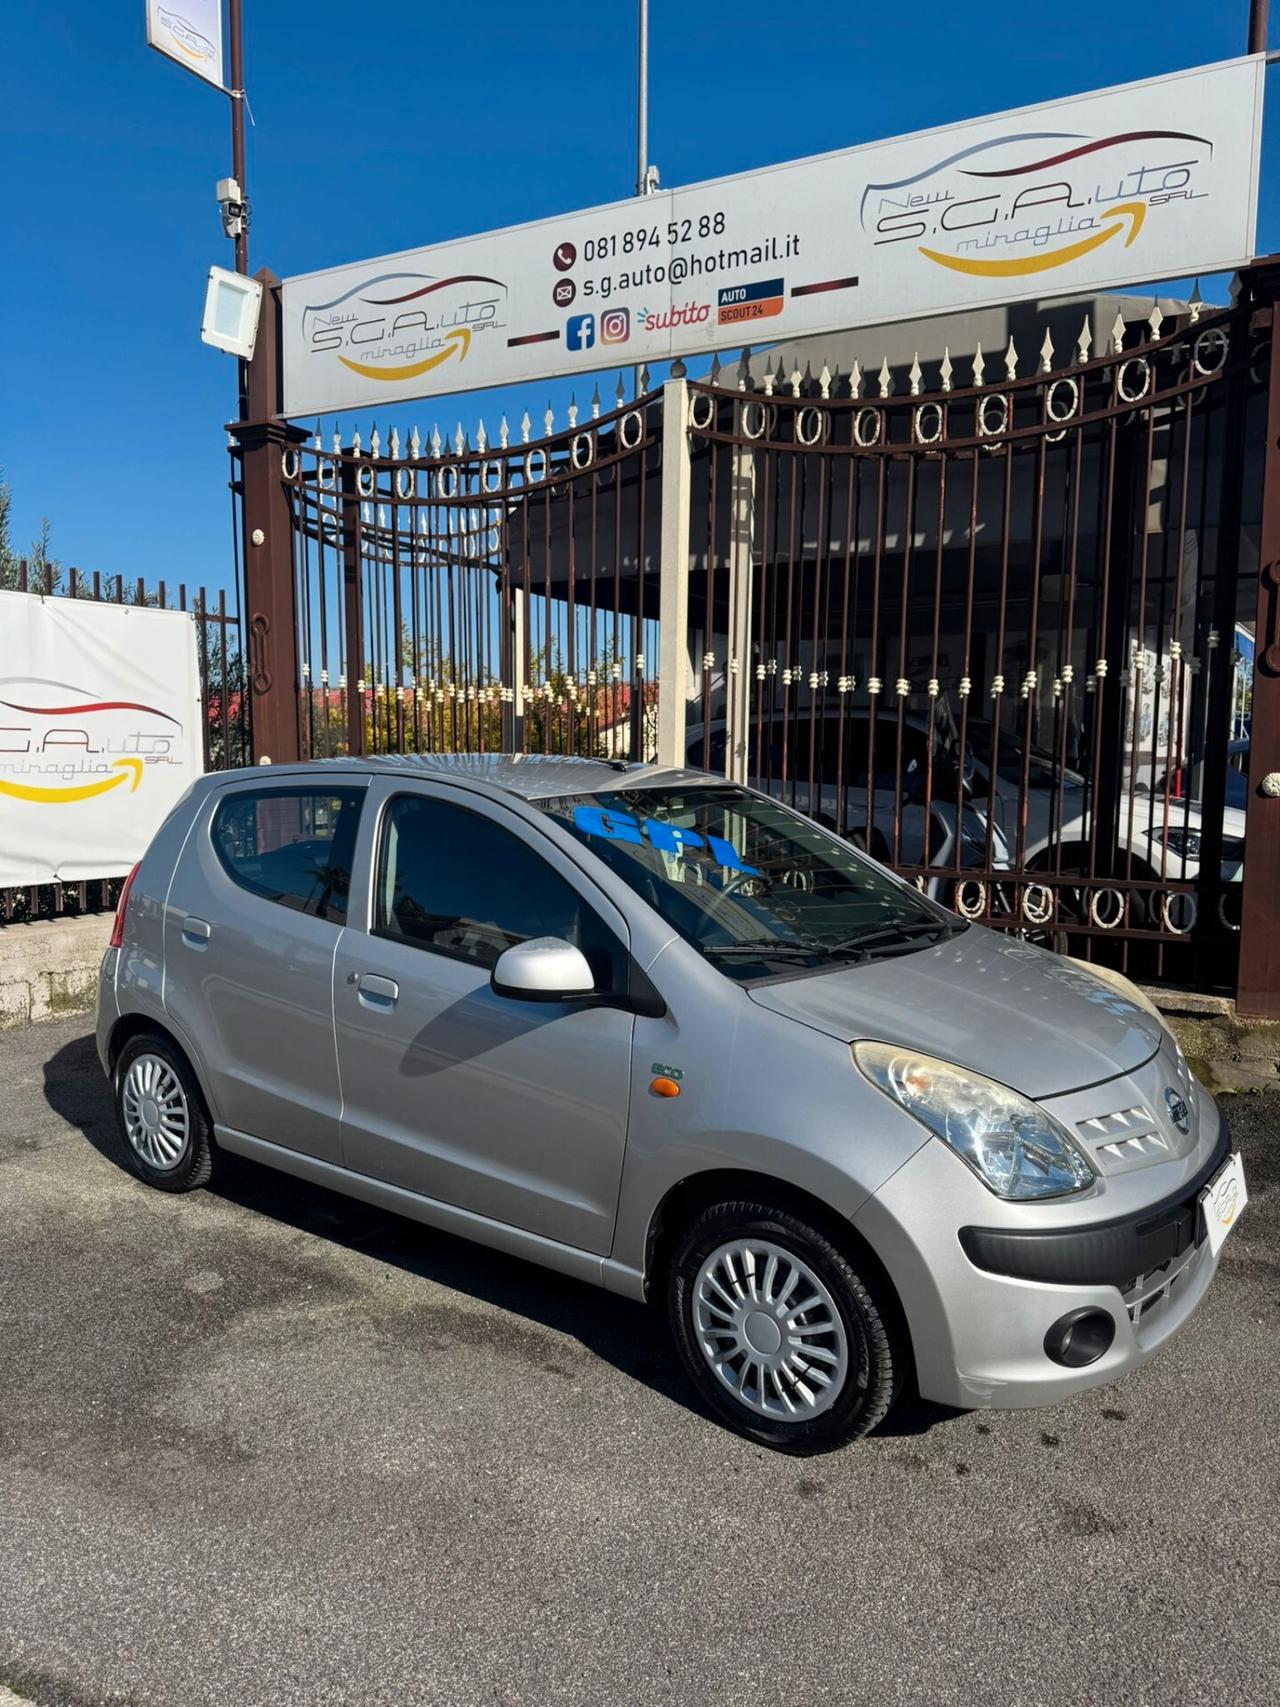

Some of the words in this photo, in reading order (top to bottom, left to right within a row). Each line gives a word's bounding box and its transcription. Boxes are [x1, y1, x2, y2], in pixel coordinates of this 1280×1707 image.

[584, 235, 617, 262] 081
[623, 226, 660, 254] 894
[668, 219, 692, 245] 52
[699, 212, 726, 238] 88
[956, 216, 1102, 253] miraglia
[583, 234, 801, 299] s.g.auto@hotmail.it
[721, 288, 747, 303] AUTO
[644, 301, 711, 332] subito
